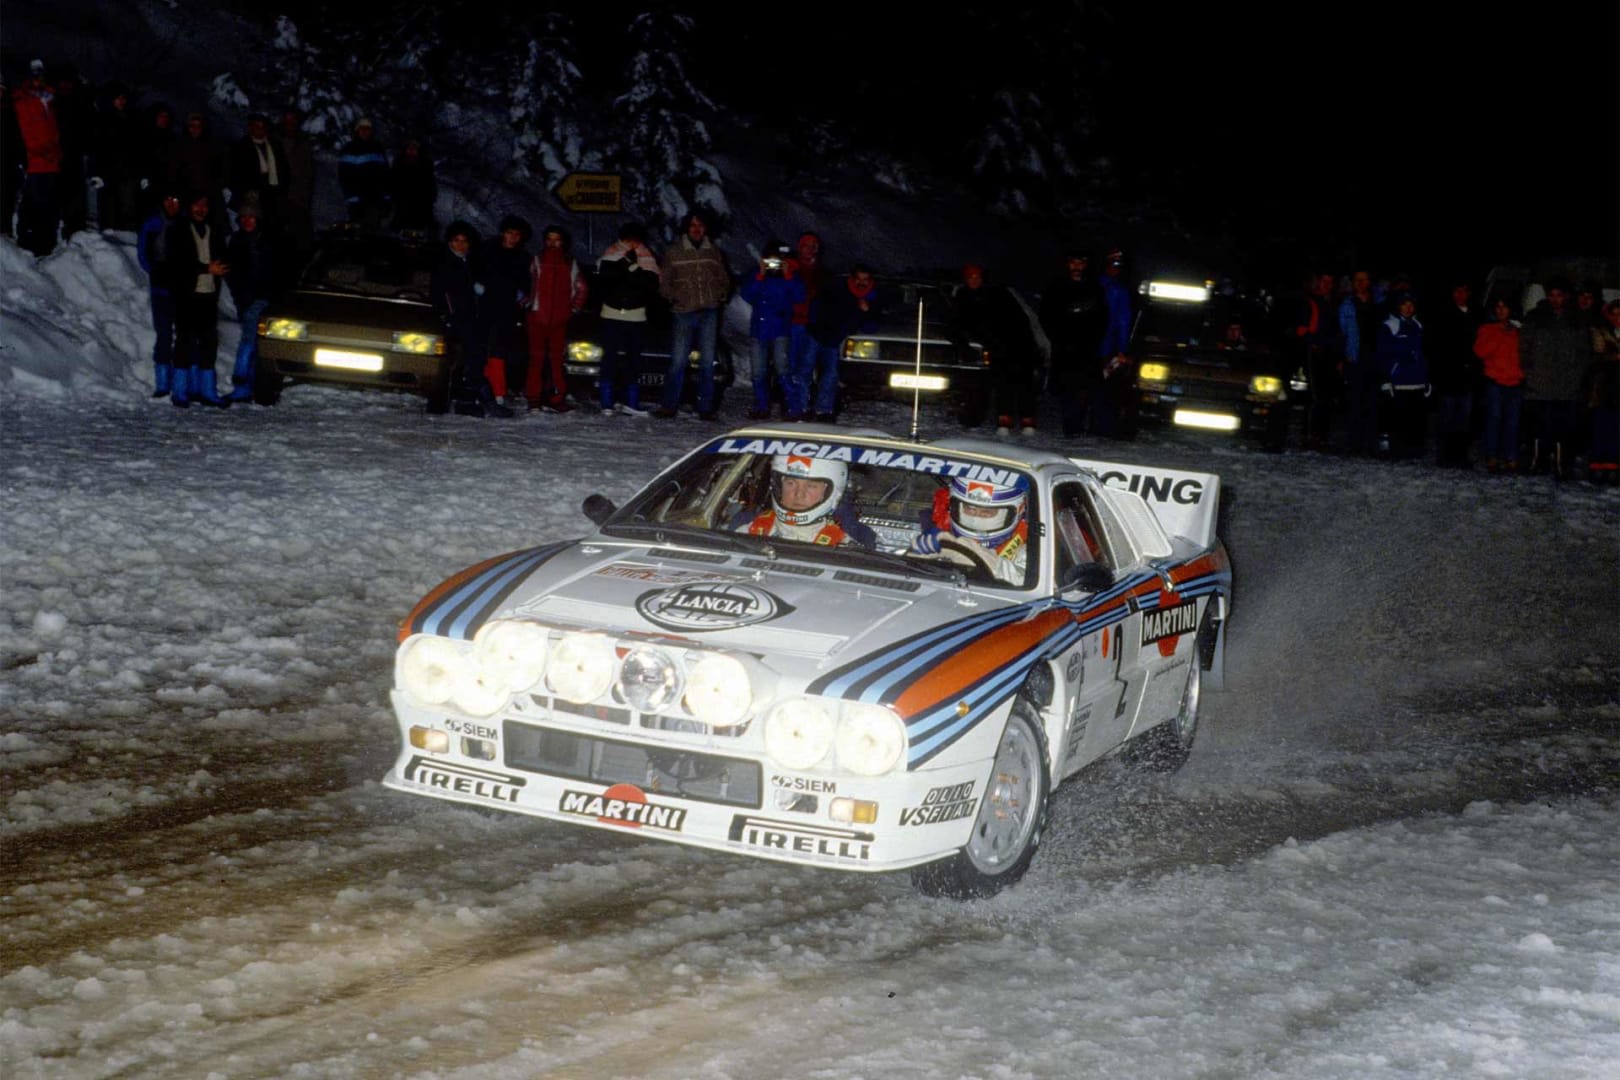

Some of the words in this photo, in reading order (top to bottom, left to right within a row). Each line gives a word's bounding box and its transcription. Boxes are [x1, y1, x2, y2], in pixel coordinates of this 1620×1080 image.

[717, 438, 853, 463] LANCIA
[855, 450, 1021, 488] MARTINI
[1099, 470, 1204, 506] CING
[675, 592, 745, 615] LANCIA
[1143, 602, 1197, 642] MARTINI
[1112, 622, 1129, 719] 2
[462, 721, 498, 740] SIEM
[403, 754, 527, 803] PIRELLI
[794, 777, 837, 794] SIEM
[923, 781, 975, 806] OLIO
[562, 791, 684, 829] MARTINI
[728, 813, 875, 860] PIRELLI
